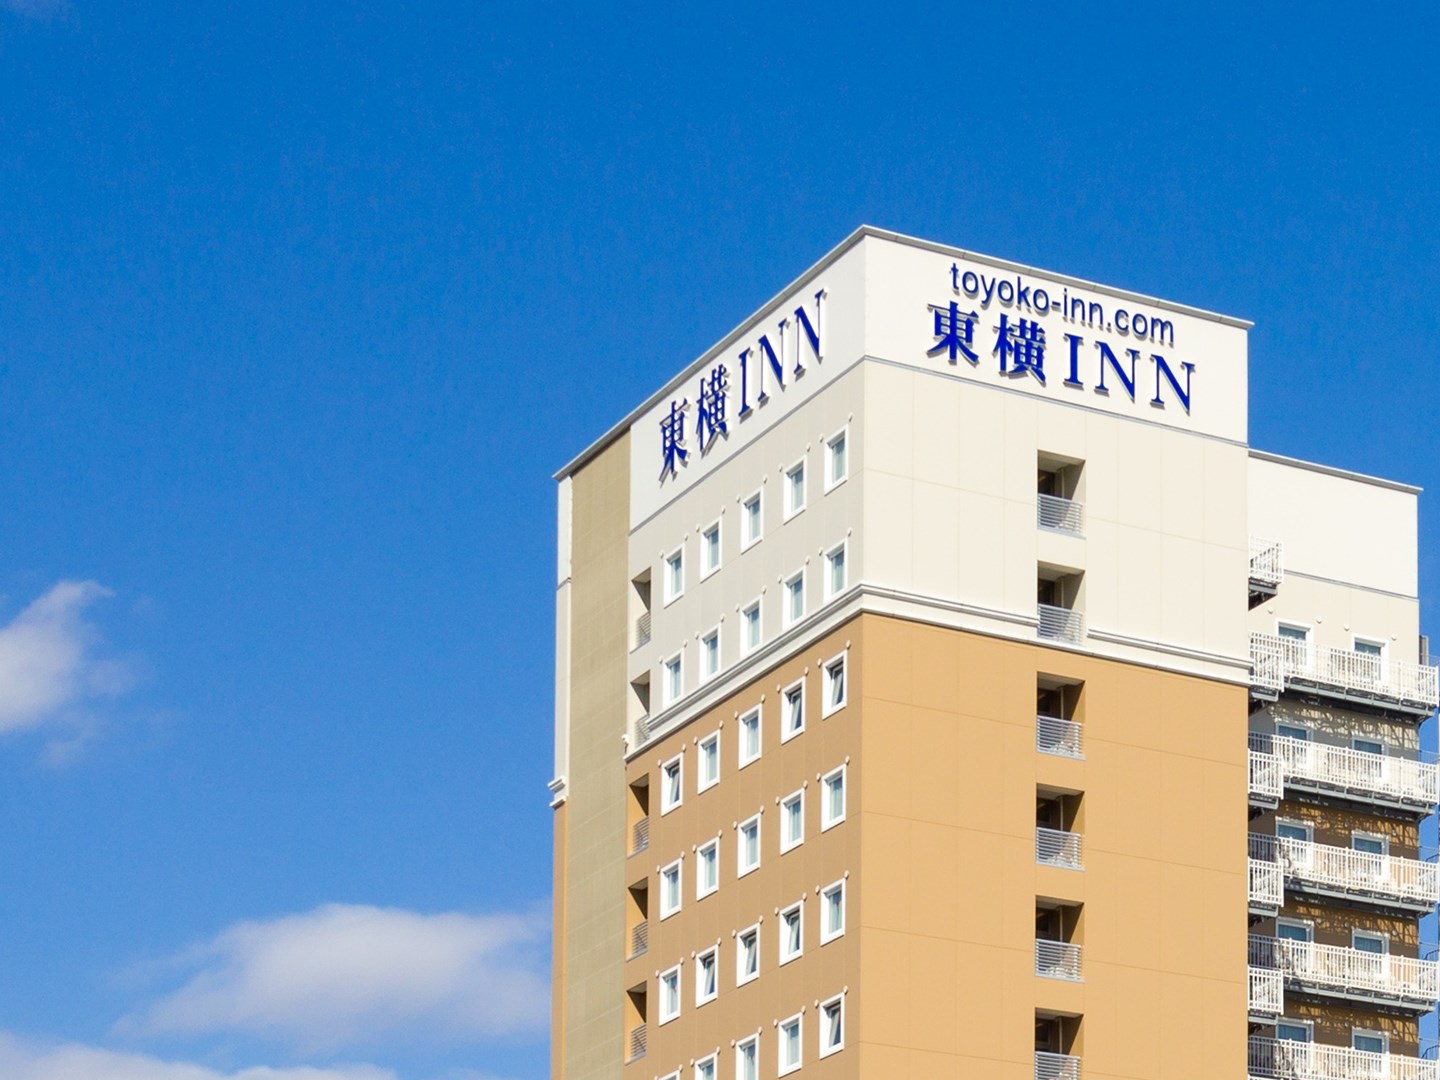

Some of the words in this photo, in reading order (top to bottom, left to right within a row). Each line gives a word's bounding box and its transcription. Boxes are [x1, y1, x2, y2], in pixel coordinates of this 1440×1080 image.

[928, 300, 1195, 413] 東横INN
[950, 262, 1175, 343] toyoko-inn.com
[659, 289, 826, 483] 東横INN
